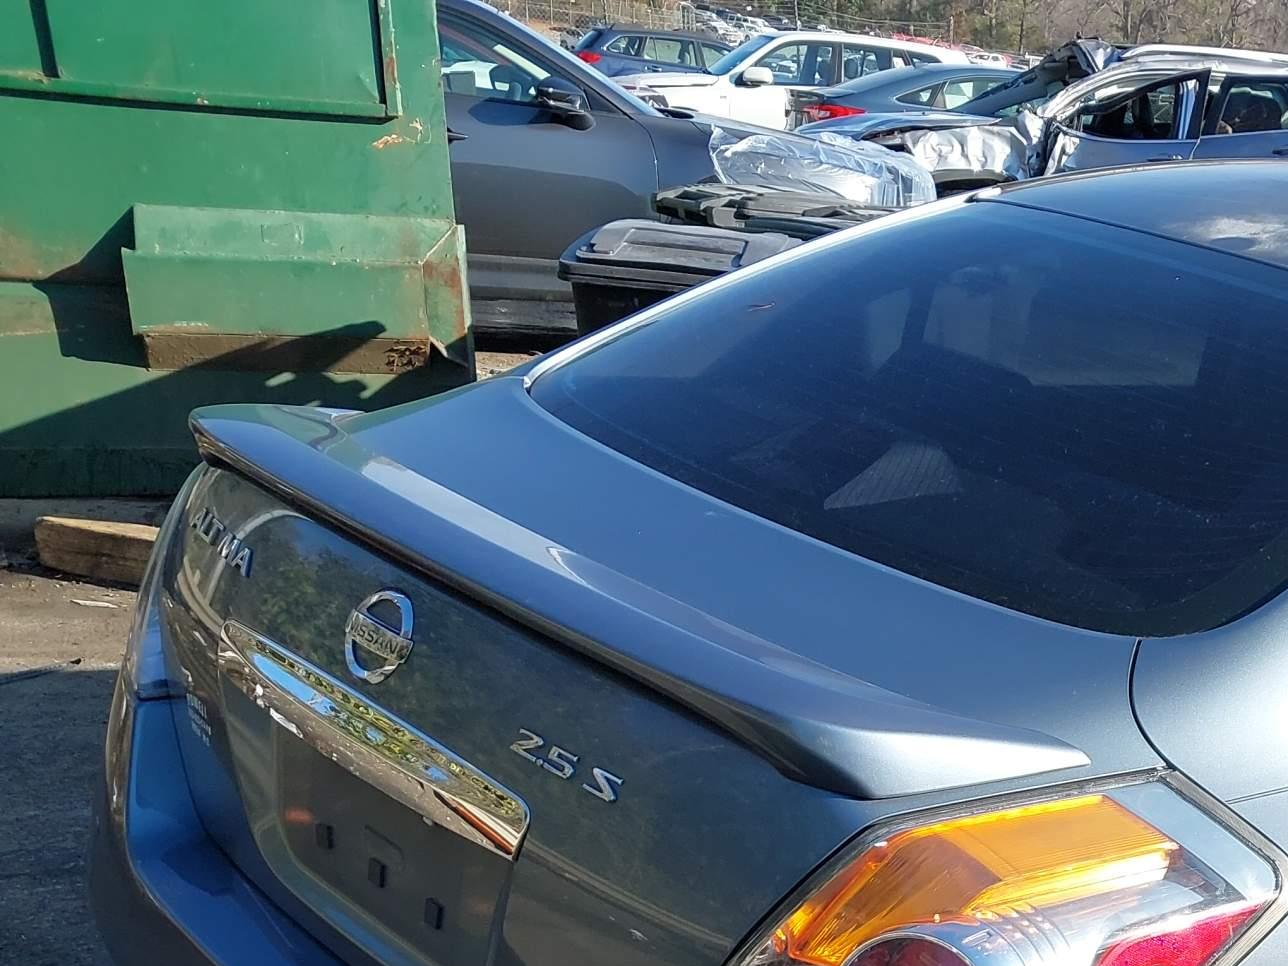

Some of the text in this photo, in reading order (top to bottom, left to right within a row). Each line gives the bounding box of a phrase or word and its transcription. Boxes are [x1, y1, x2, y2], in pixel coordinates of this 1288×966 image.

[346, 611, 399, 654] NISSAN
[509, 728, 624, 802] 2.5 S
